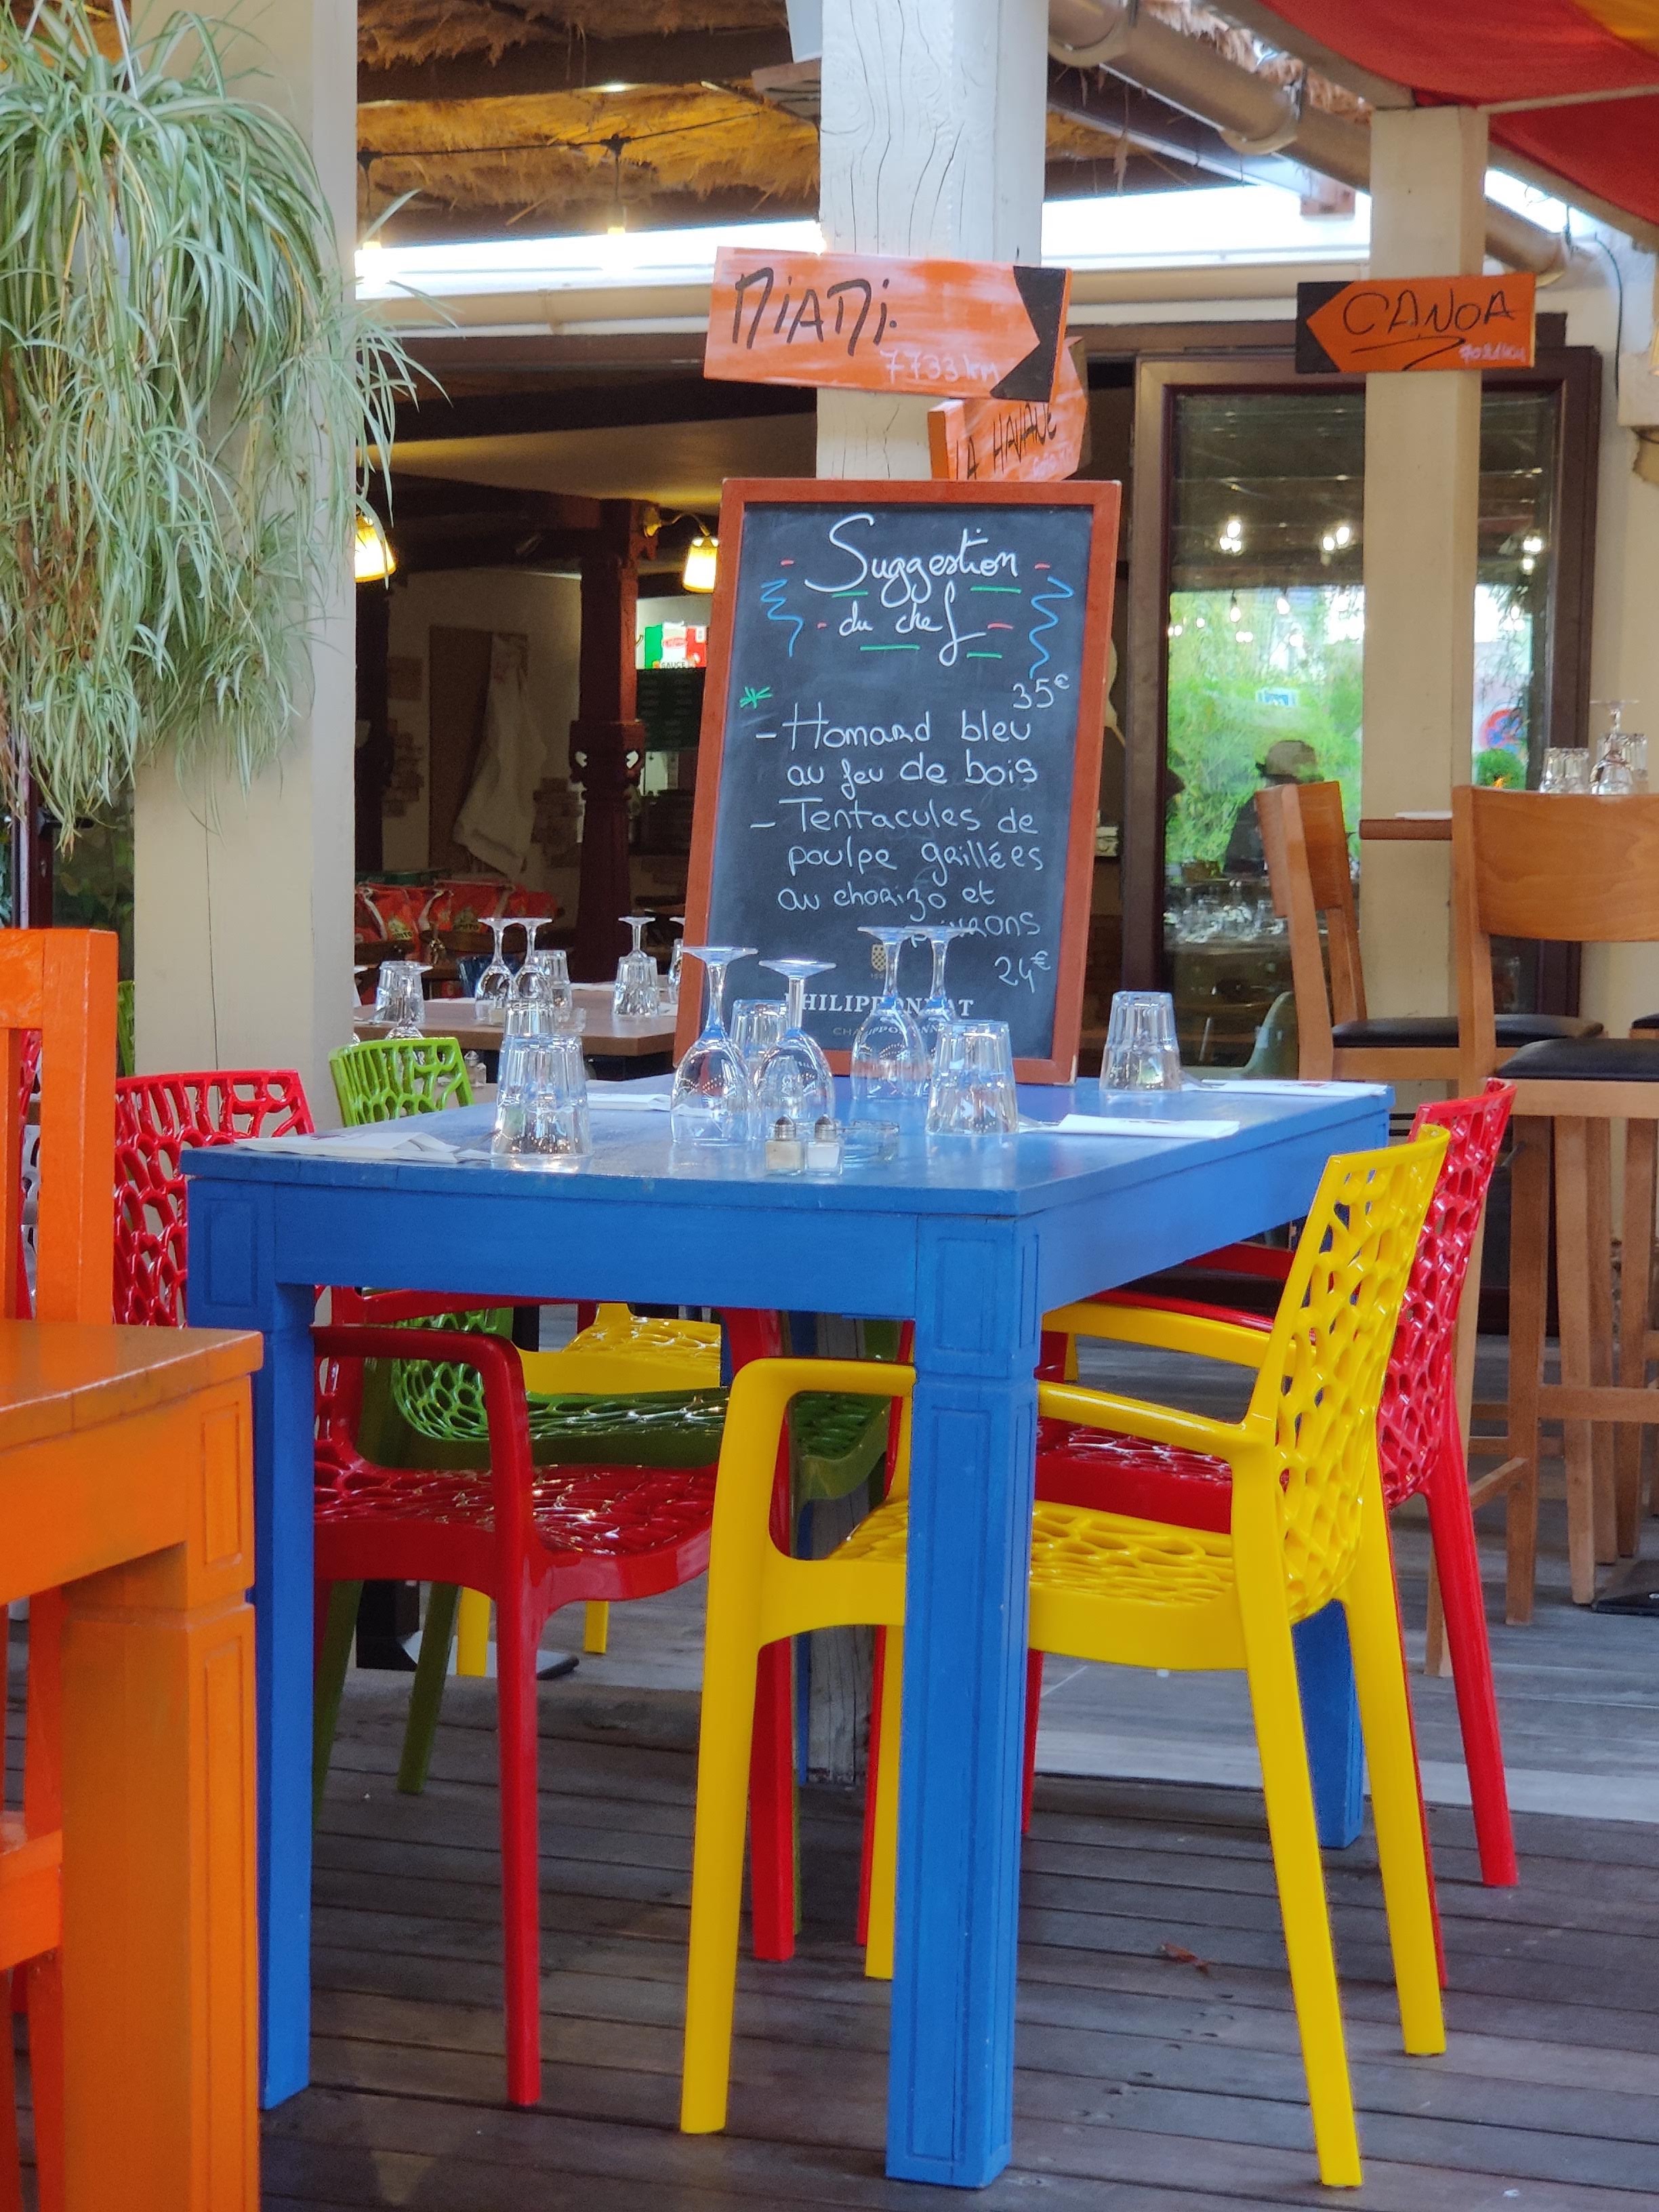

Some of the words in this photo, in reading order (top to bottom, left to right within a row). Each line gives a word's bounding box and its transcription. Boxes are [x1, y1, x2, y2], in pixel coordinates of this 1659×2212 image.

[1343, 288, 1515, 335] CANOA
[804, 513, 1019, 609] Suggestion
[838, 600, 874, 636] du
[895, 579, 987, 667] chef
[960, 709, 1032, 740] bleu
[787, 764, 824, 785] au
[840, 758, 884, 800] feu
[899, 752, 948, 784] de
[965, 749, 1038, 785] bois
[779, 798, 981, 833] Tentacules
[997, 807, 1039, 835] de
[788, 836, 898, 876] poulpe
[777, 888, 820, 912] au
[962, 881, 996, 905] et
